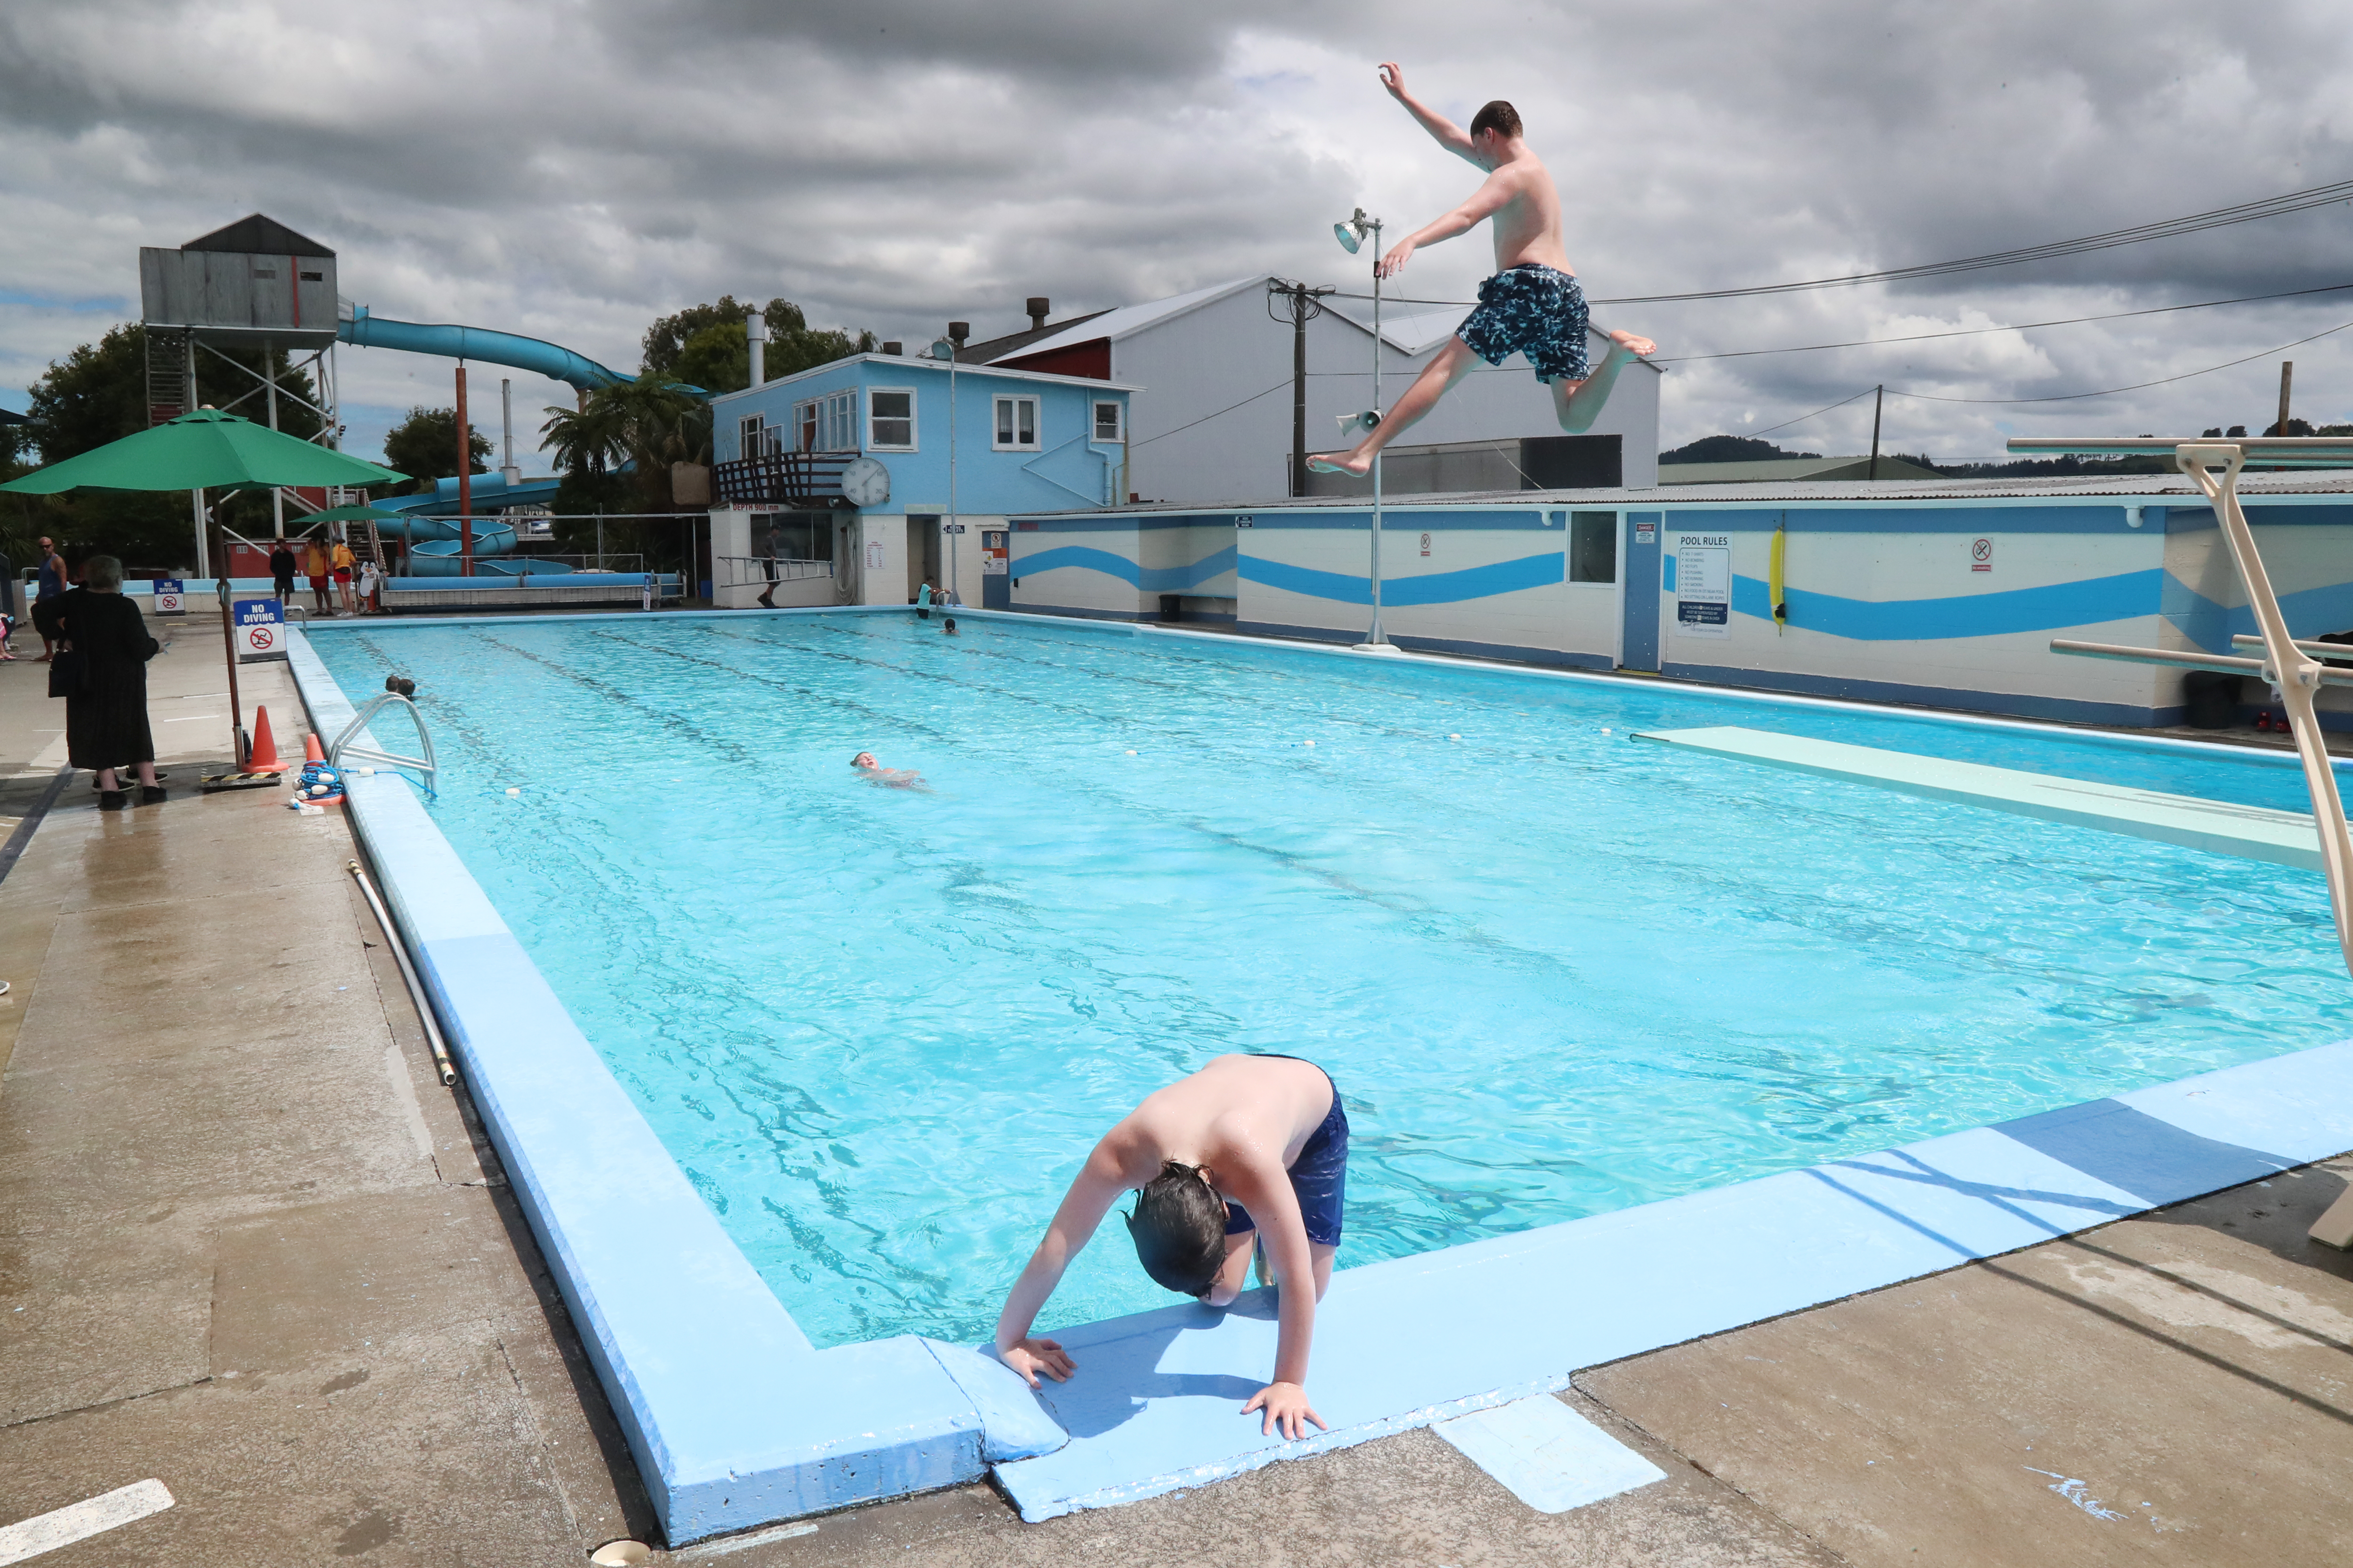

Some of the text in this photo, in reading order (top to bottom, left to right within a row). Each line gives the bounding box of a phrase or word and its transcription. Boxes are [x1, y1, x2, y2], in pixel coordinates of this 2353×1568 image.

[1681, 537, 1728, 545] POOL RULES
[252, 604, 265, 613] NO
[243, 613, 275, 622] DIVING
